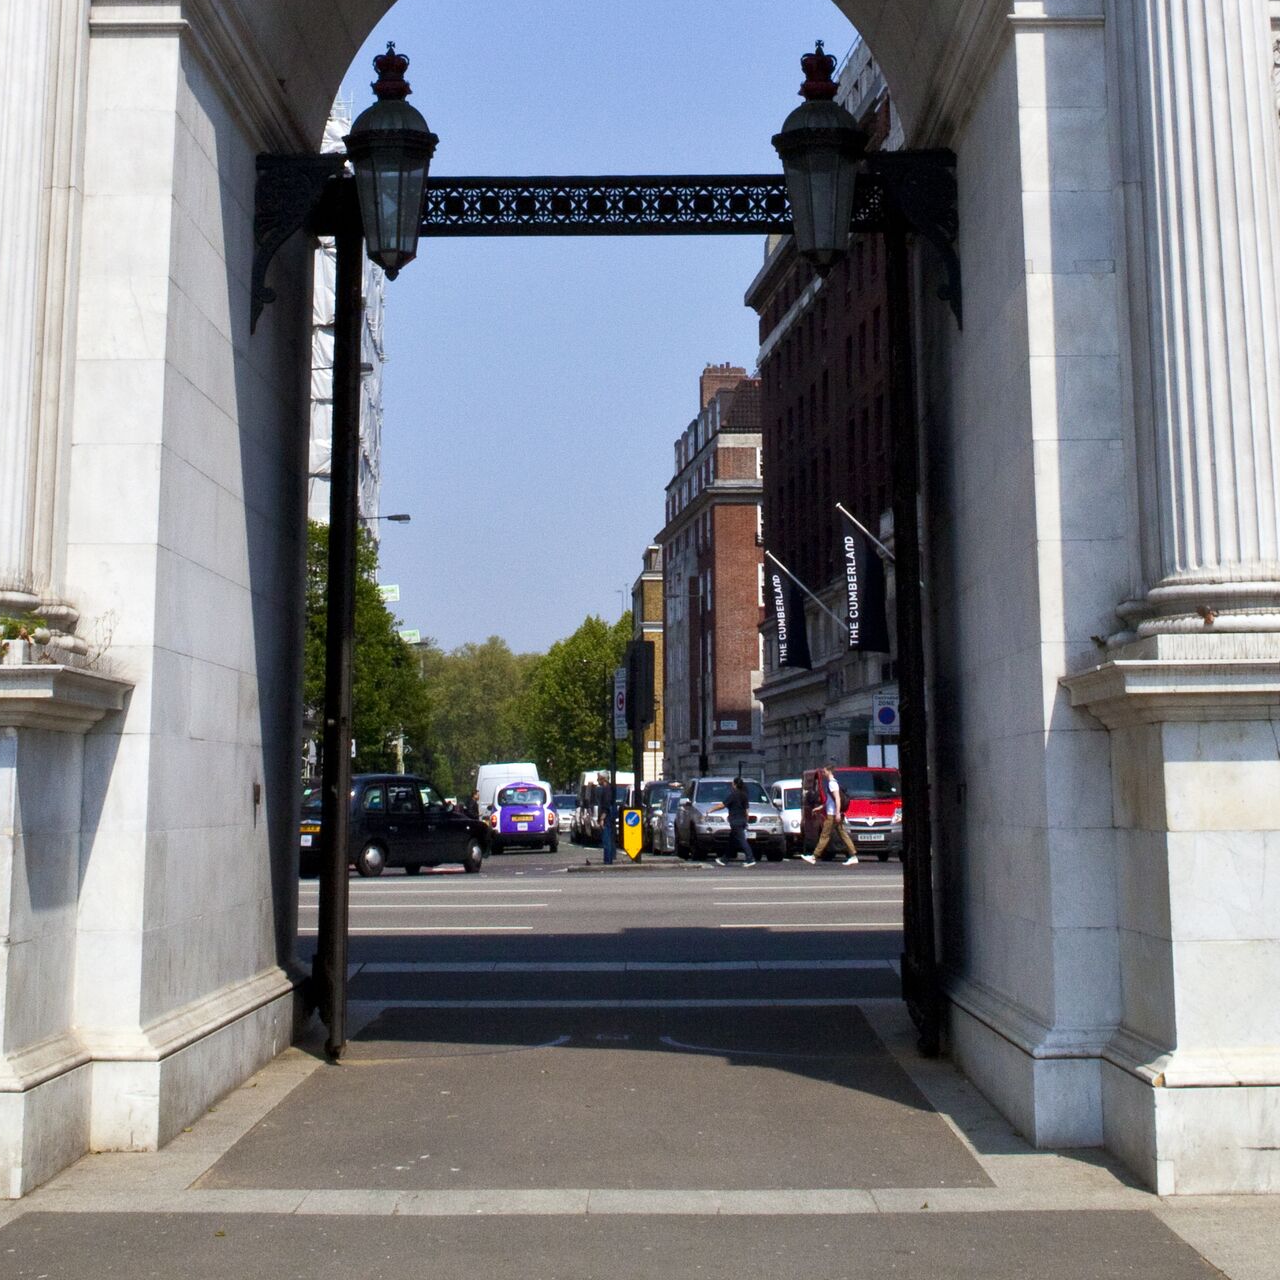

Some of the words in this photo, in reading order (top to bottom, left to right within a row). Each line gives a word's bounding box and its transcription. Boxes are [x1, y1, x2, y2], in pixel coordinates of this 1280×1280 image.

[844, 536, 859, 618] CUMBERLAND
[772, 574, 787, 640] CUMBERLAND
[779, 643, 787, 663] THE
[849, 622, 859, 646] THE
